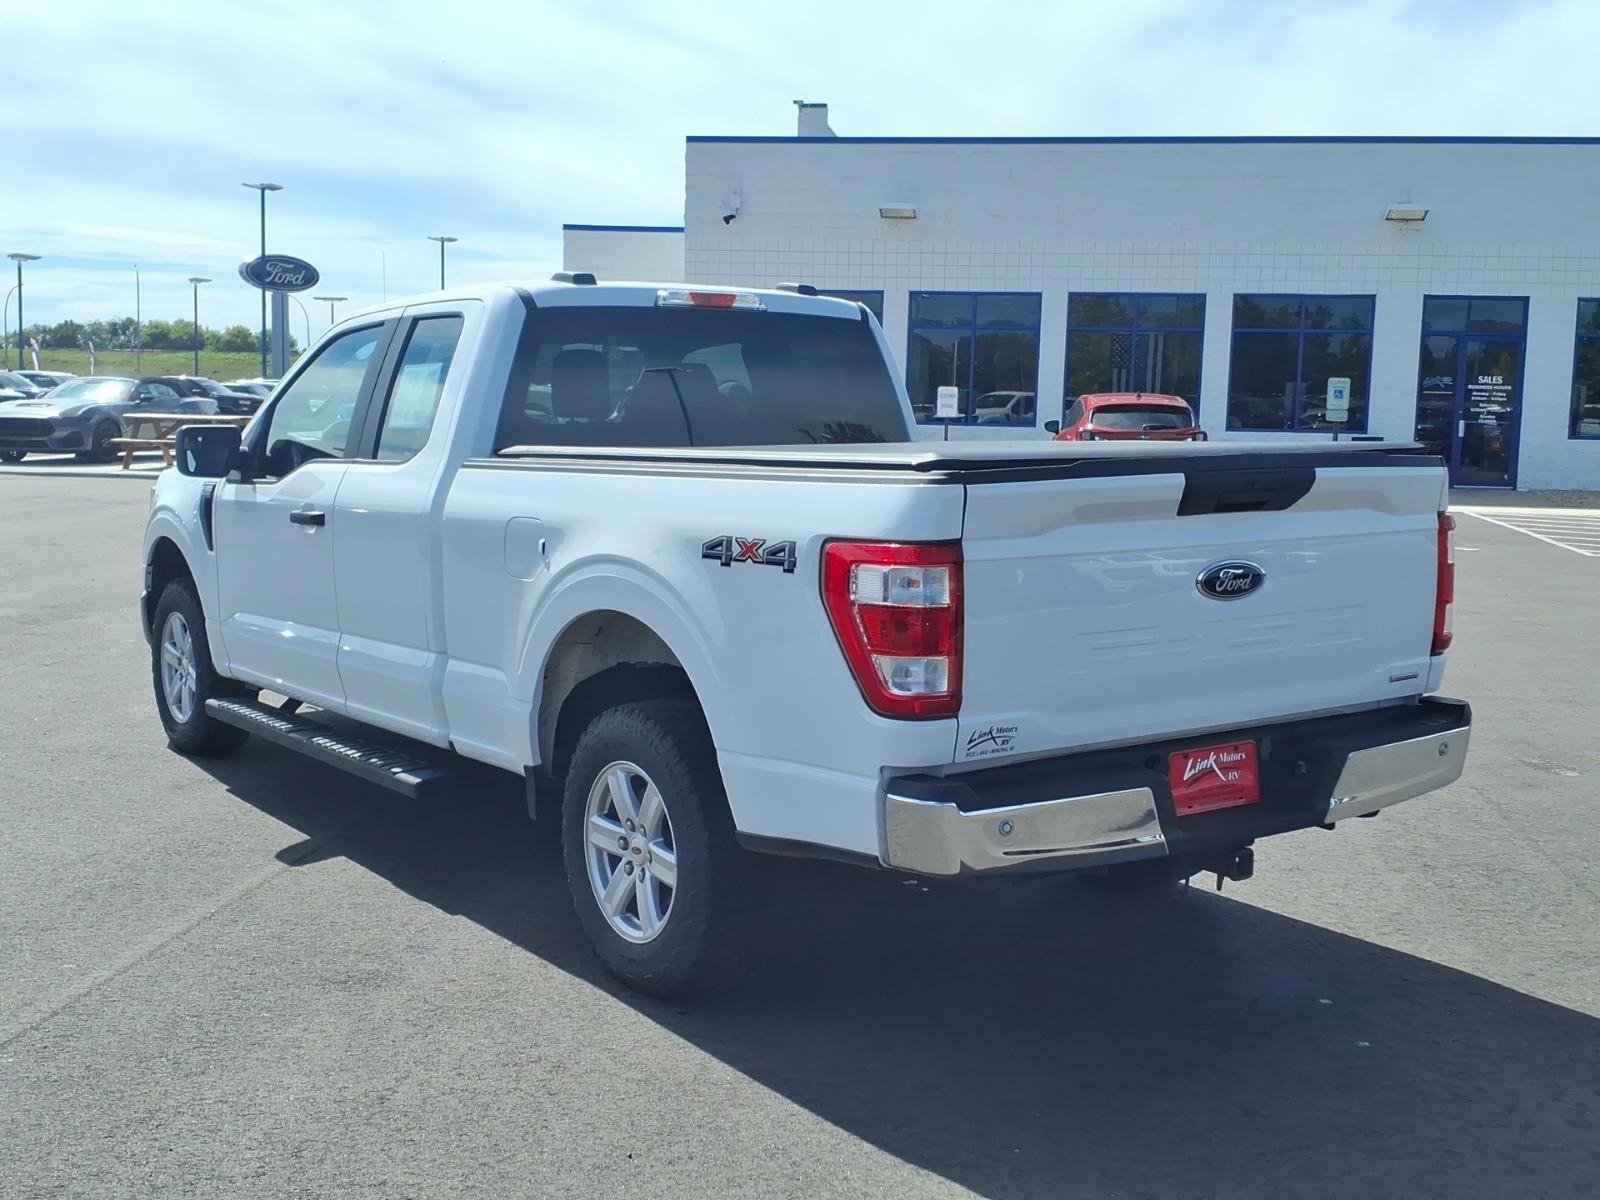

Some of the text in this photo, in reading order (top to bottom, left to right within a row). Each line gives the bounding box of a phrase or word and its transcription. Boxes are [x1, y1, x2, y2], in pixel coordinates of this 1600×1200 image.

[265, 261, 306, 285] Ford
[1215, 568, 1253, 592] Ford
[967, 726, 1018, 746] Link Motors
[1183, 751, 1247, 781] Link Motors
[1227, 770, 1241, 781] RV
